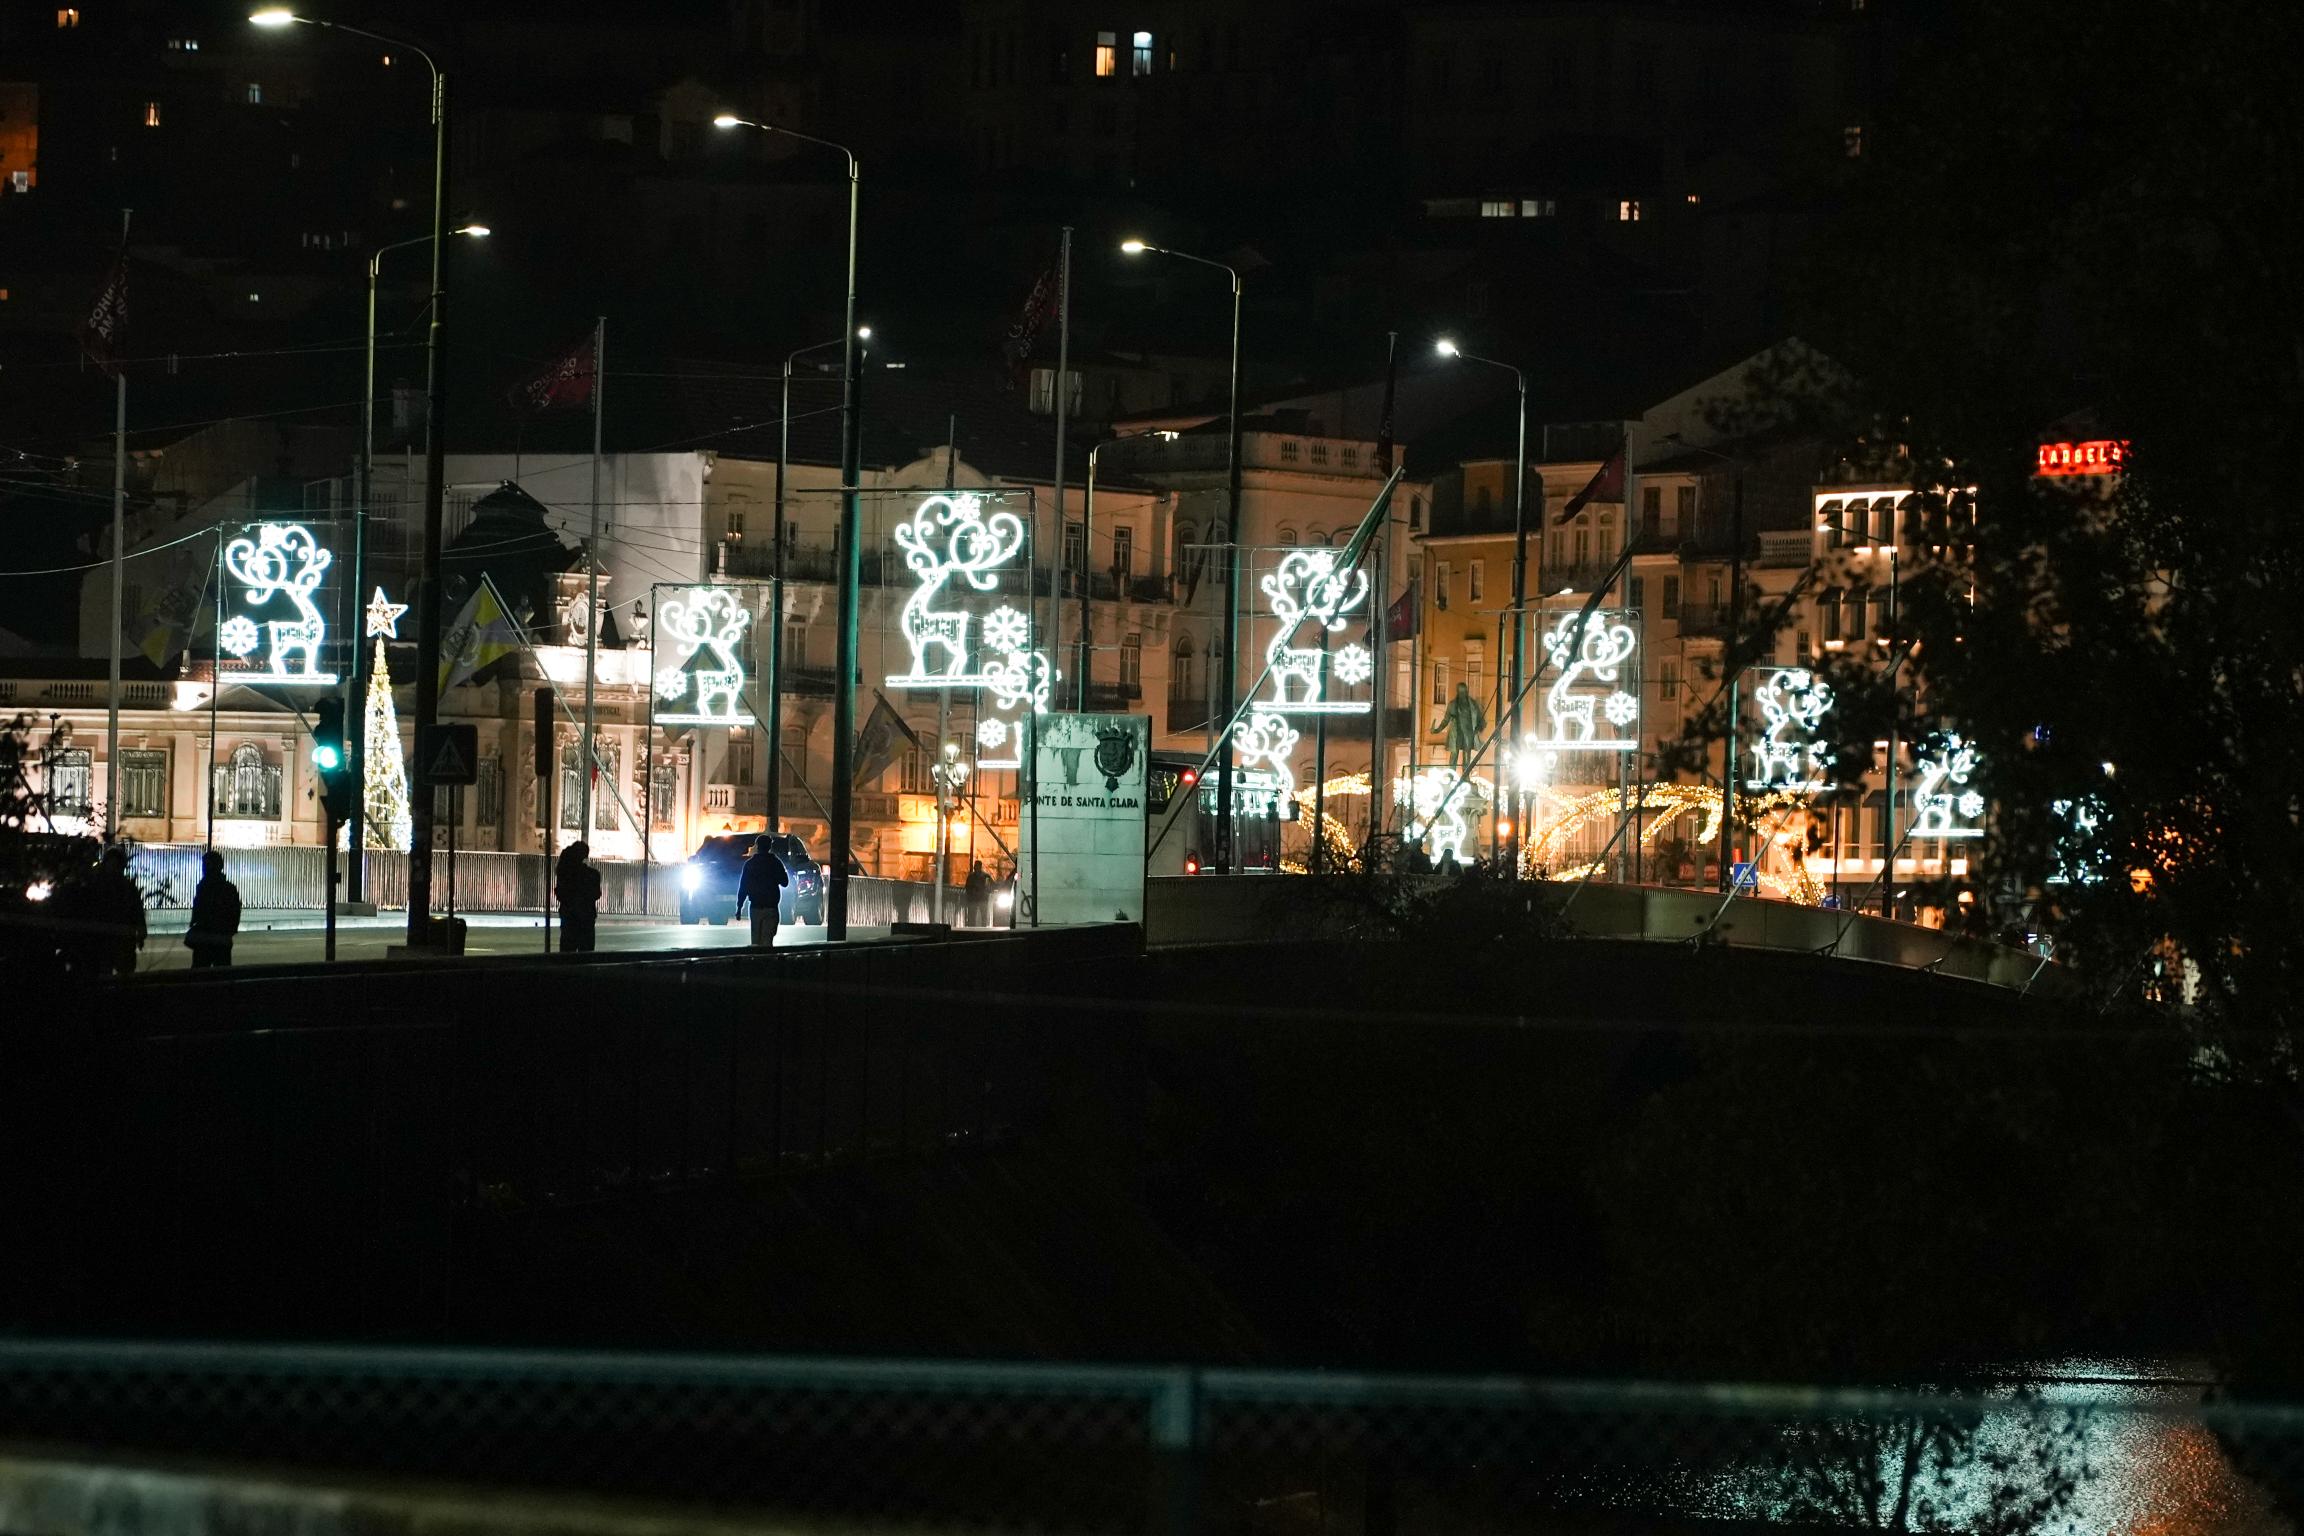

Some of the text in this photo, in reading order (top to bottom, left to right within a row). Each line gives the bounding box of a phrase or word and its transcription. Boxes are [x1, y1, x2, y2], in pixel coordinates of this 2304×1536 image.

[1024, 795, 1139, 809] PNTE DE SANTA CLARA
